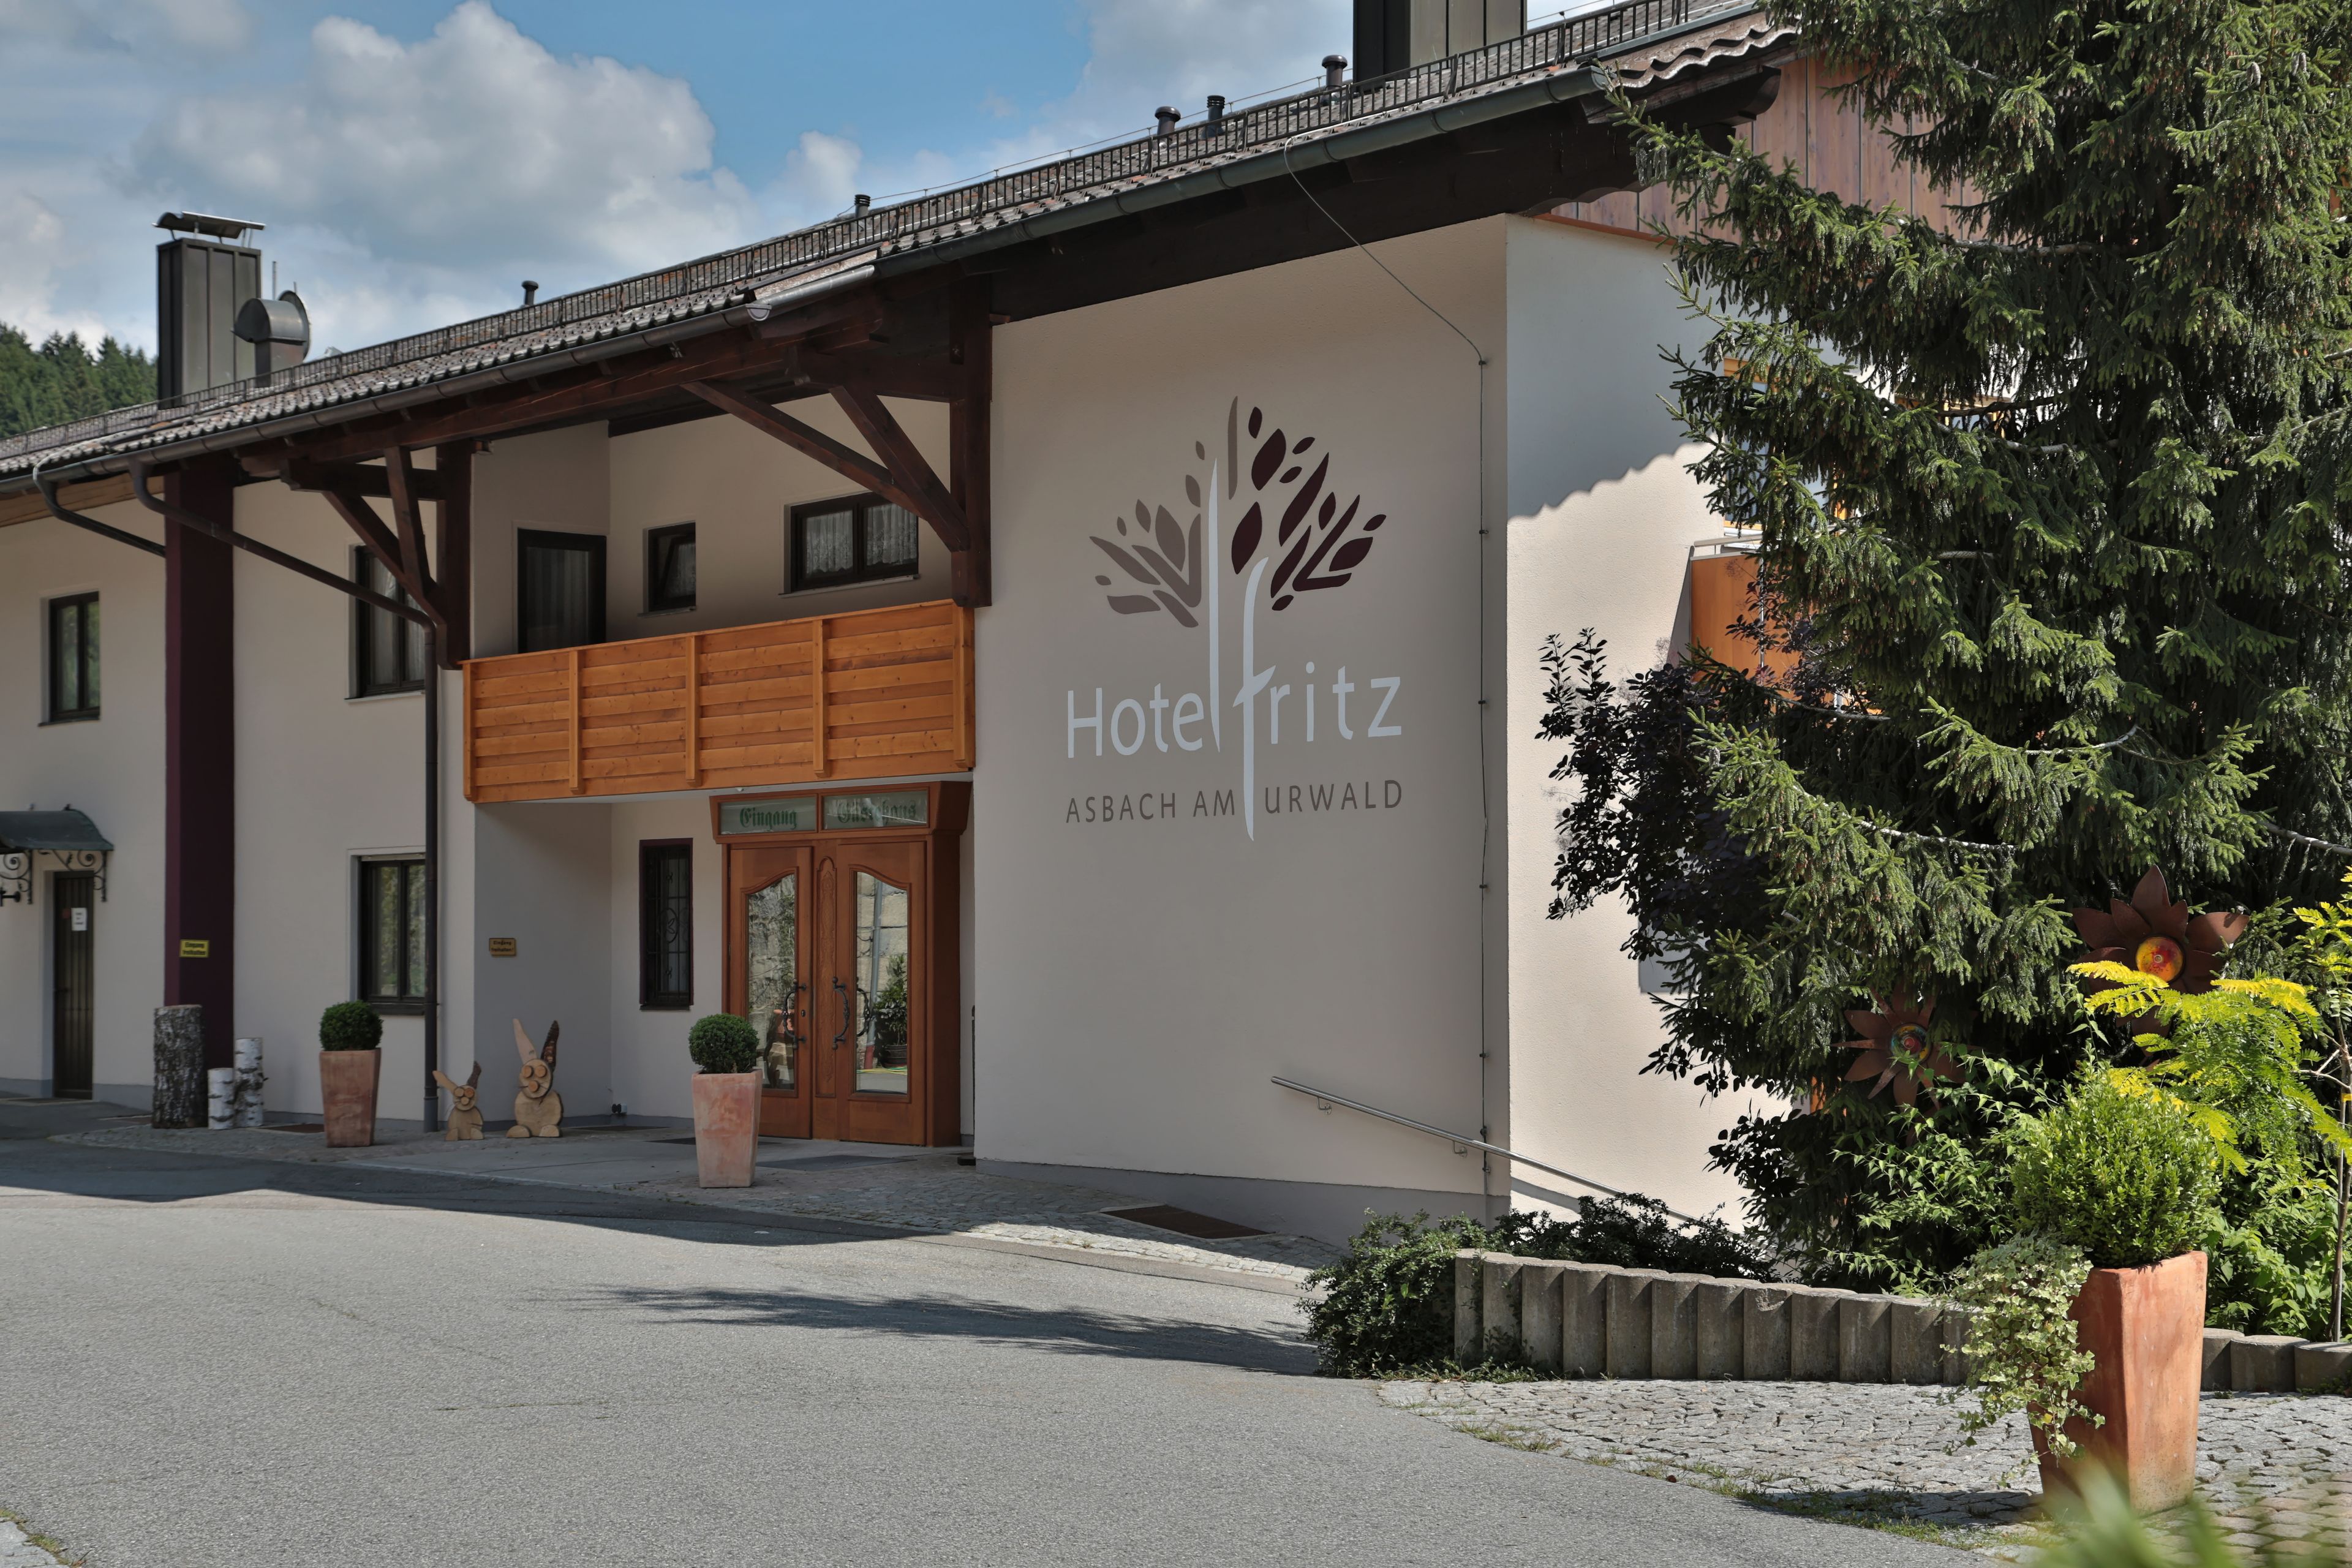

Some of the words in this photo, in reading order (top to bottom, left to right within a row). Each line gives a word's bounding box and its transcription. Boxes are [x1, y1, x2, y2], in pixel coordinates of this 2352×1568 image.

[1066, 793, 1175, 823] ASBACH
[1193, 790, 1235, 817] AM
[1265, 780, 1402, 813] URWALD
[740, 807, 797, 829] Eingang
